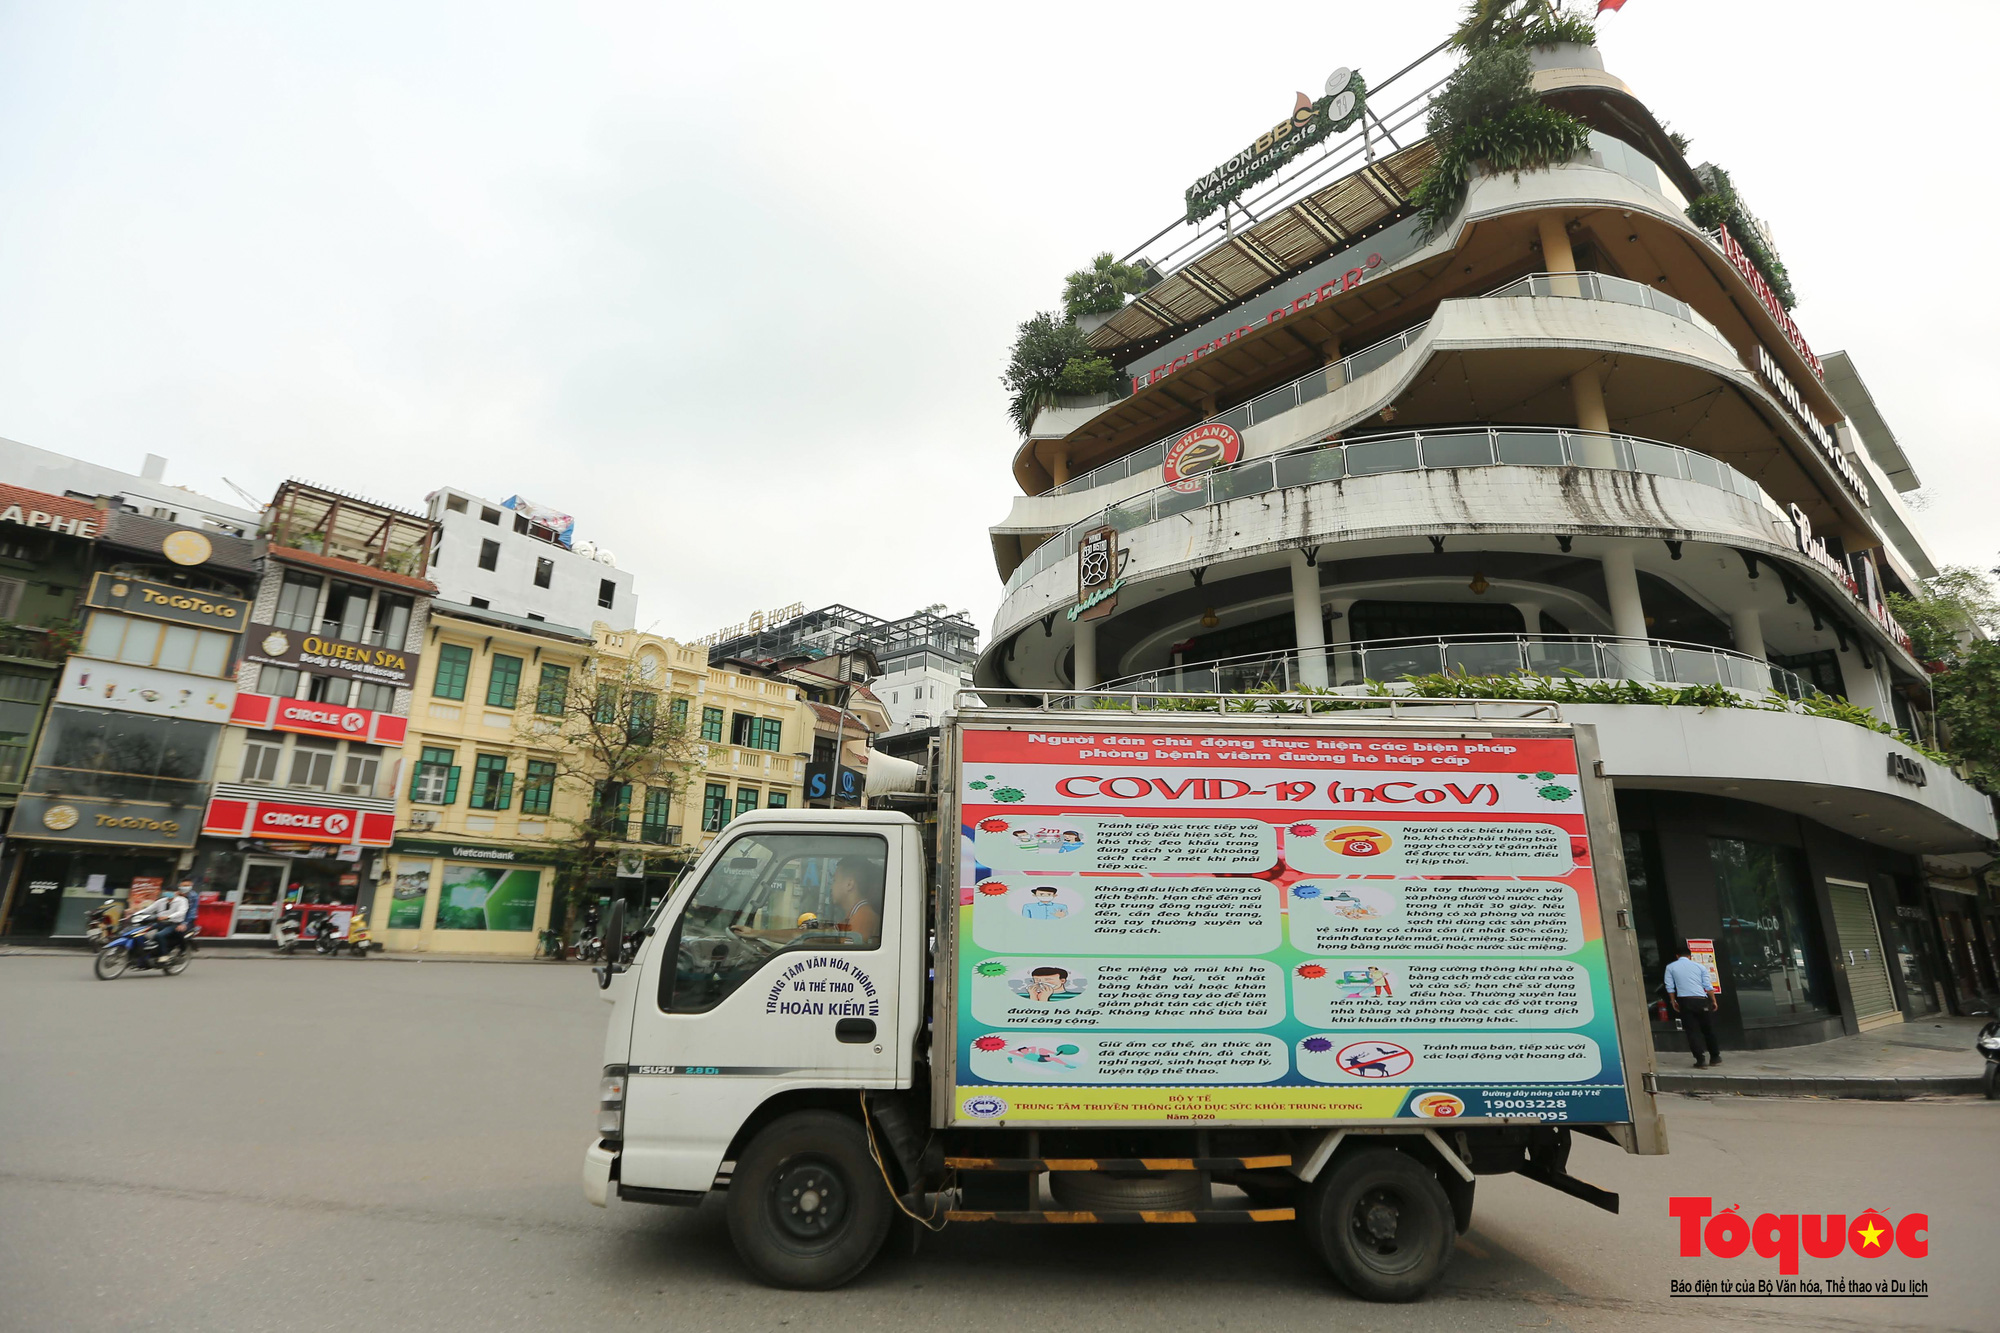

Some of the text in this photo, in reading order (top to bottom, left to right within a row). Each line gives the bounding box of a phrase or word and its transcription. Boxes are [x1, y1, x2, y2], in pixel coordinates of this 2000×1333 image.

[1191, 147, 1253, 198] AVALON
[1759, 345, 1834, 459] HIGHLANDS
[1166, 427, 1235, 468] HIGHLANDS
[768, 601, 803, 626] HOTEL
[302, 637, 371, 664] QUEEN
[373, 651, 406, 670] SPA
[300, 653, 327, 668] Body
[329, 657, 339, 668] &
[339, 660, 363, 672] Foot
[363, 663, 406, 681] Massage
[284, 707, 340, 725] CIRCLE
[1055, 776, 1499, 806] COVID-19 (nCoV)
[262, 812, 322, 828] CIRCLE
[452, 847, 515, 860] Vietcombank
[766, 956, 879, 1016] TRUNG TÂM VĂN HÓA THÔNG TIN
[829, 982, 854, 993] THAO
[780, 998, 865, 1016] HOÀN KIẾM
[638, 1066, 675, 1074] ISUZU
[1056, 1102, 1080, 1110] TÂM
[1083, 1102, 1128, 1110] TRUYỀN
[1174, 1101, 1201, 1110] GIÁO
[1169, 1094, 1184, 1103] BỘ
[1484, 1099, 1566, 1108] 19003228
